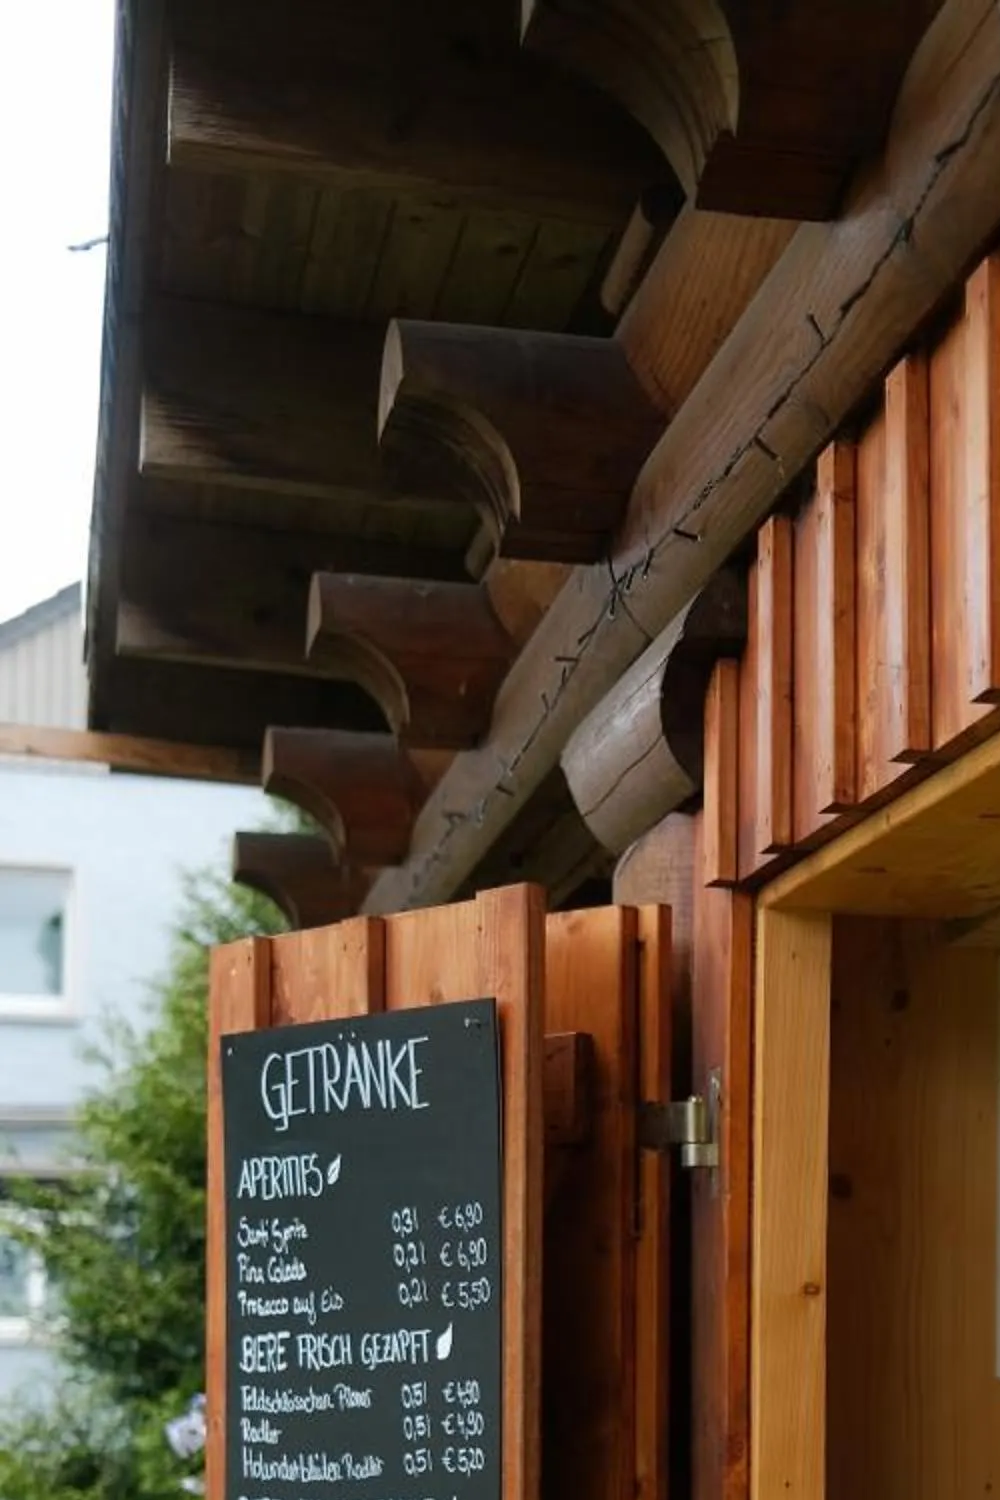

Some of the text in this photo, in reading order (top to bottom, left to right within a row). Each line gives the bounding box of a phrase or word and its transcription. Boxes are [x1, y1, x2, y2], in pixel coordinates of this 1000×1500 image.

[261, 1031, 430, 1131] GETRÄNKE
[237, 1152, 323, 1200] APERITIFS
[267, 1256, 307, 1283] Colada
[237, 1290, 289, 1317] Prosecco
[293, 1290, 317, 1326] auf
[321, 1285, 344, 1313] Eis
[240, 1329, 432, 1372] BIERE FRISCH GEZAPFT
[240, 1417, 283, 1444] Radler
[341, 1452, 385, 1480] Radler
